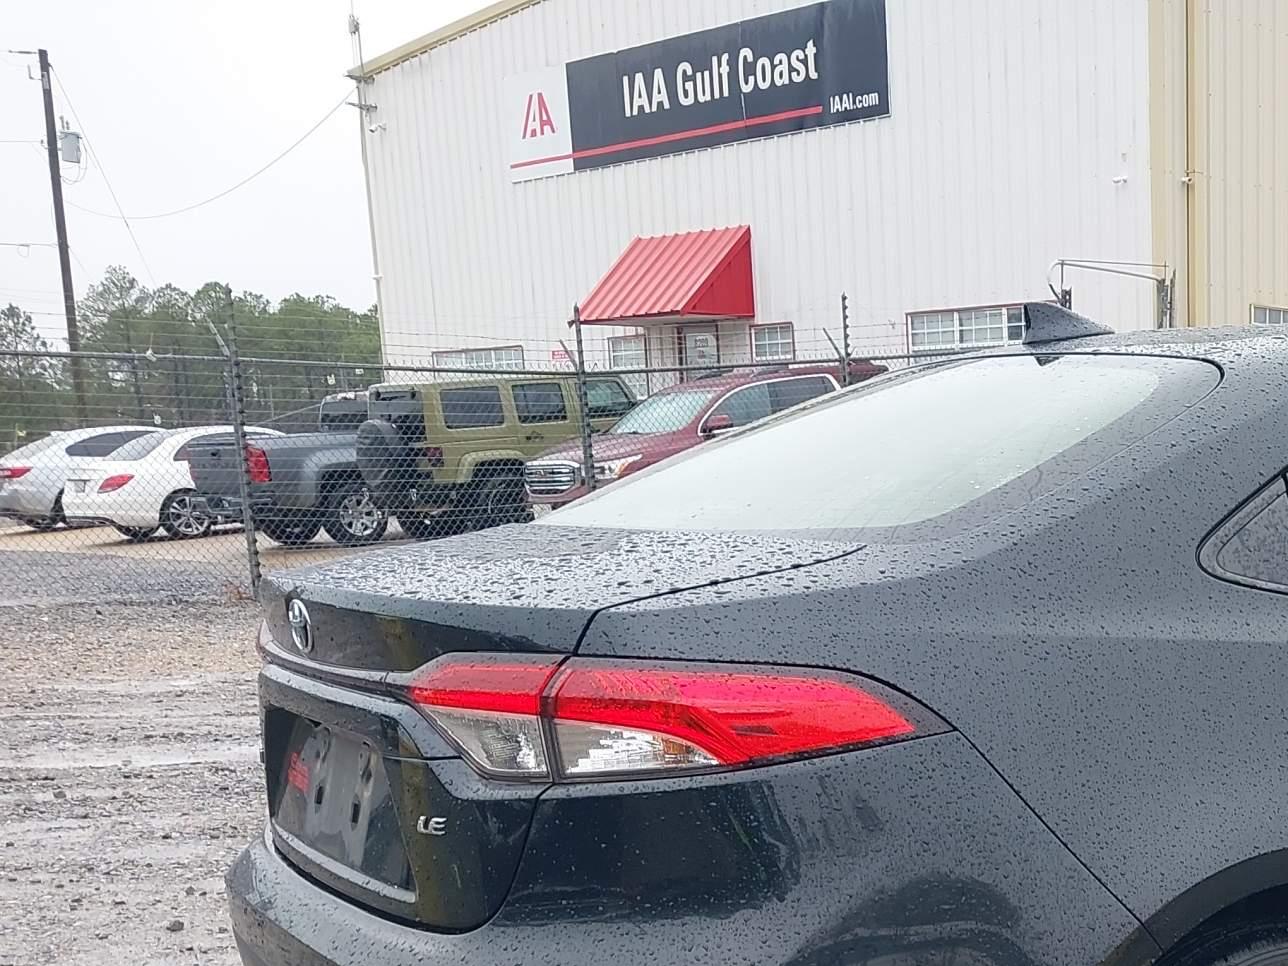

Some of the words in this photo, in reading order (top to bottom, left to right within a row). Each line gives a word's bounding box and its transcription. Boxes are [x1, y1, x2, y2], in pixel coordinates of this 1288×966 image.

[623, 67, 669, 118] IAA
[676, 53, 729, 106] Gulf
[739, 39, 818, 94] Coast
[416, 815, 447, 836] LE
